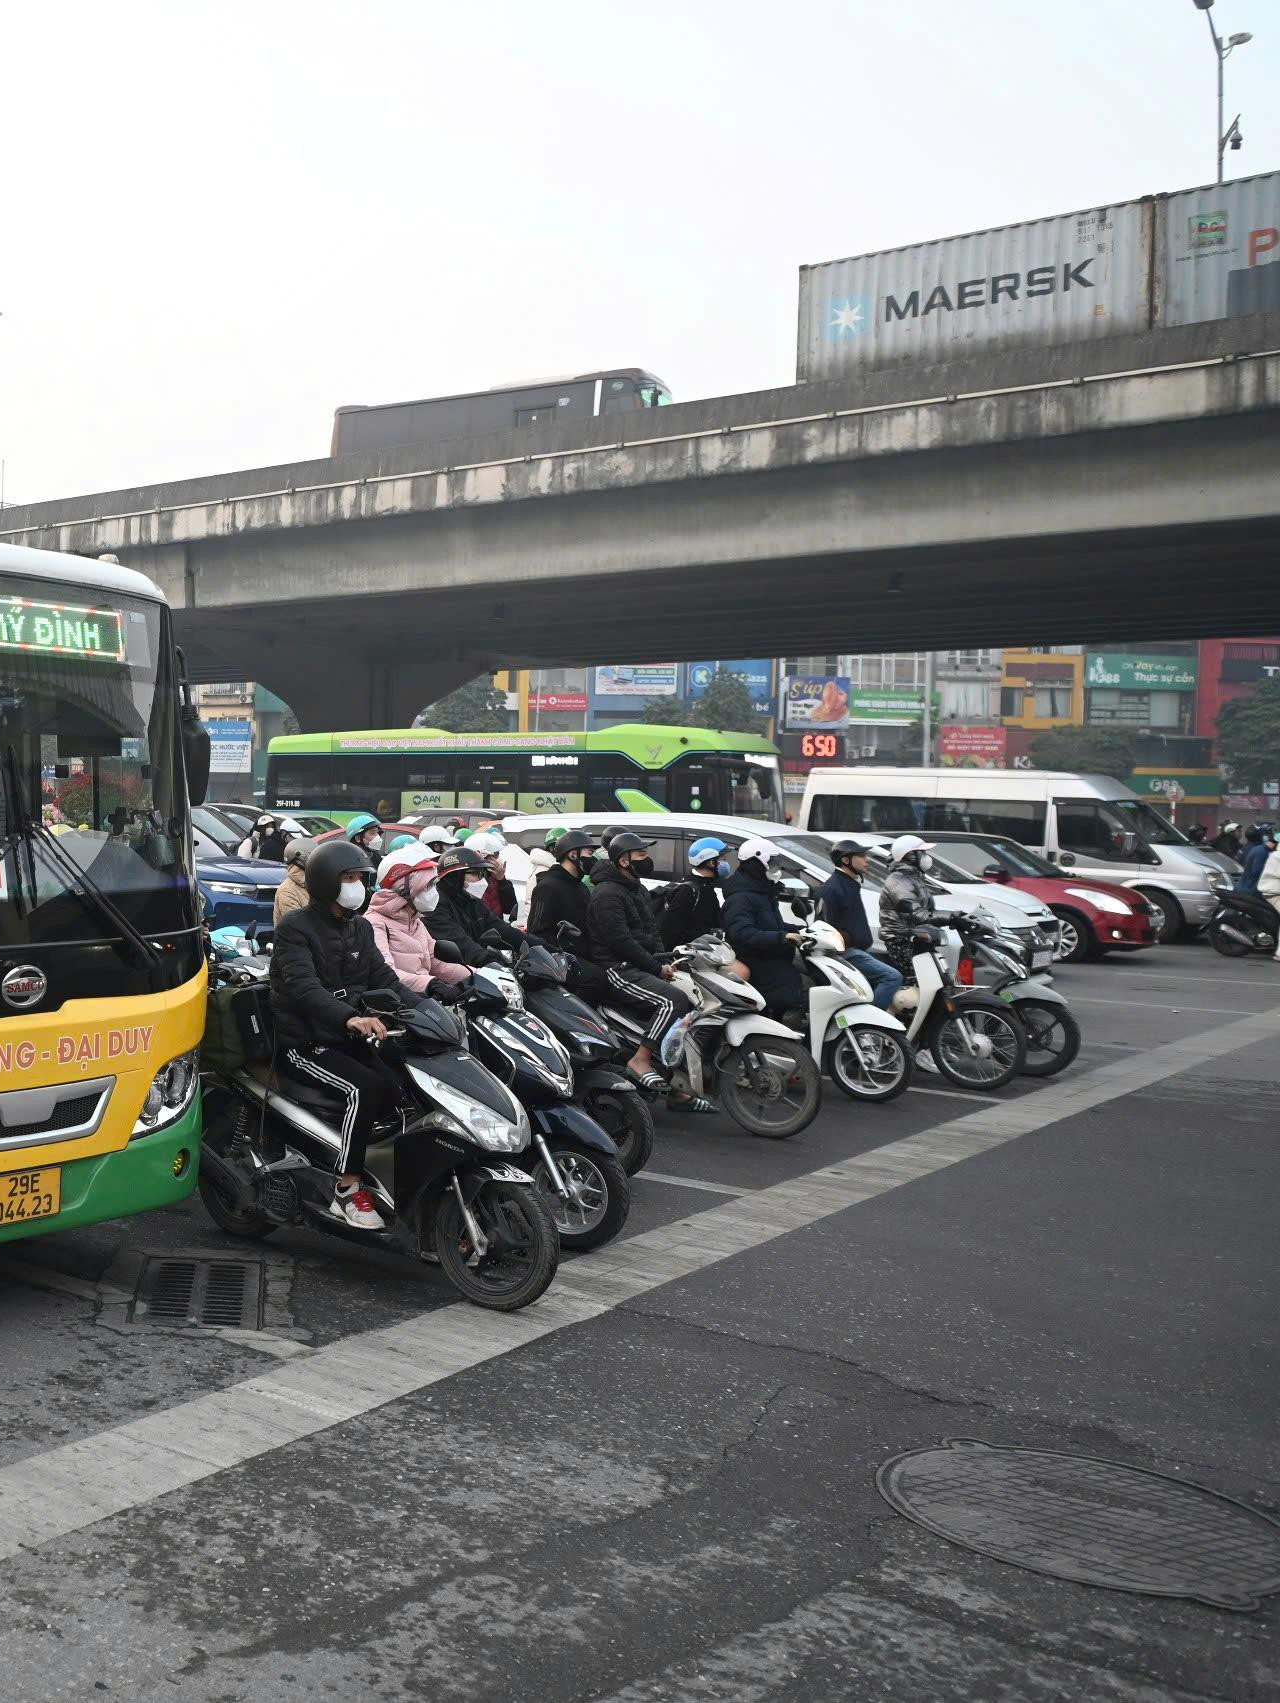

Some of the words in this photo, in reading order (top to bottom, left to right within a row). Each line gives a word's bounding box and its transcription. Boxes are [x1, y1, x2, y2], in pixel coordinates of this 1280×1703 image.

[884, 257, 1096, 322] MAERSK
[32, 611, 102, 650] ĐÌNH
[802, 735, 836, 757] 650
[5, 980, 46, 994] SAMCO
[41, 1051, 51, 1060] -
[56, 1031, 101, 1071] ĐẠI
[106, 1025, 154, 1058] DUY
[434, 1136, 465, 1154] HONDA
[7, 1172, 41, 1198] 29E
